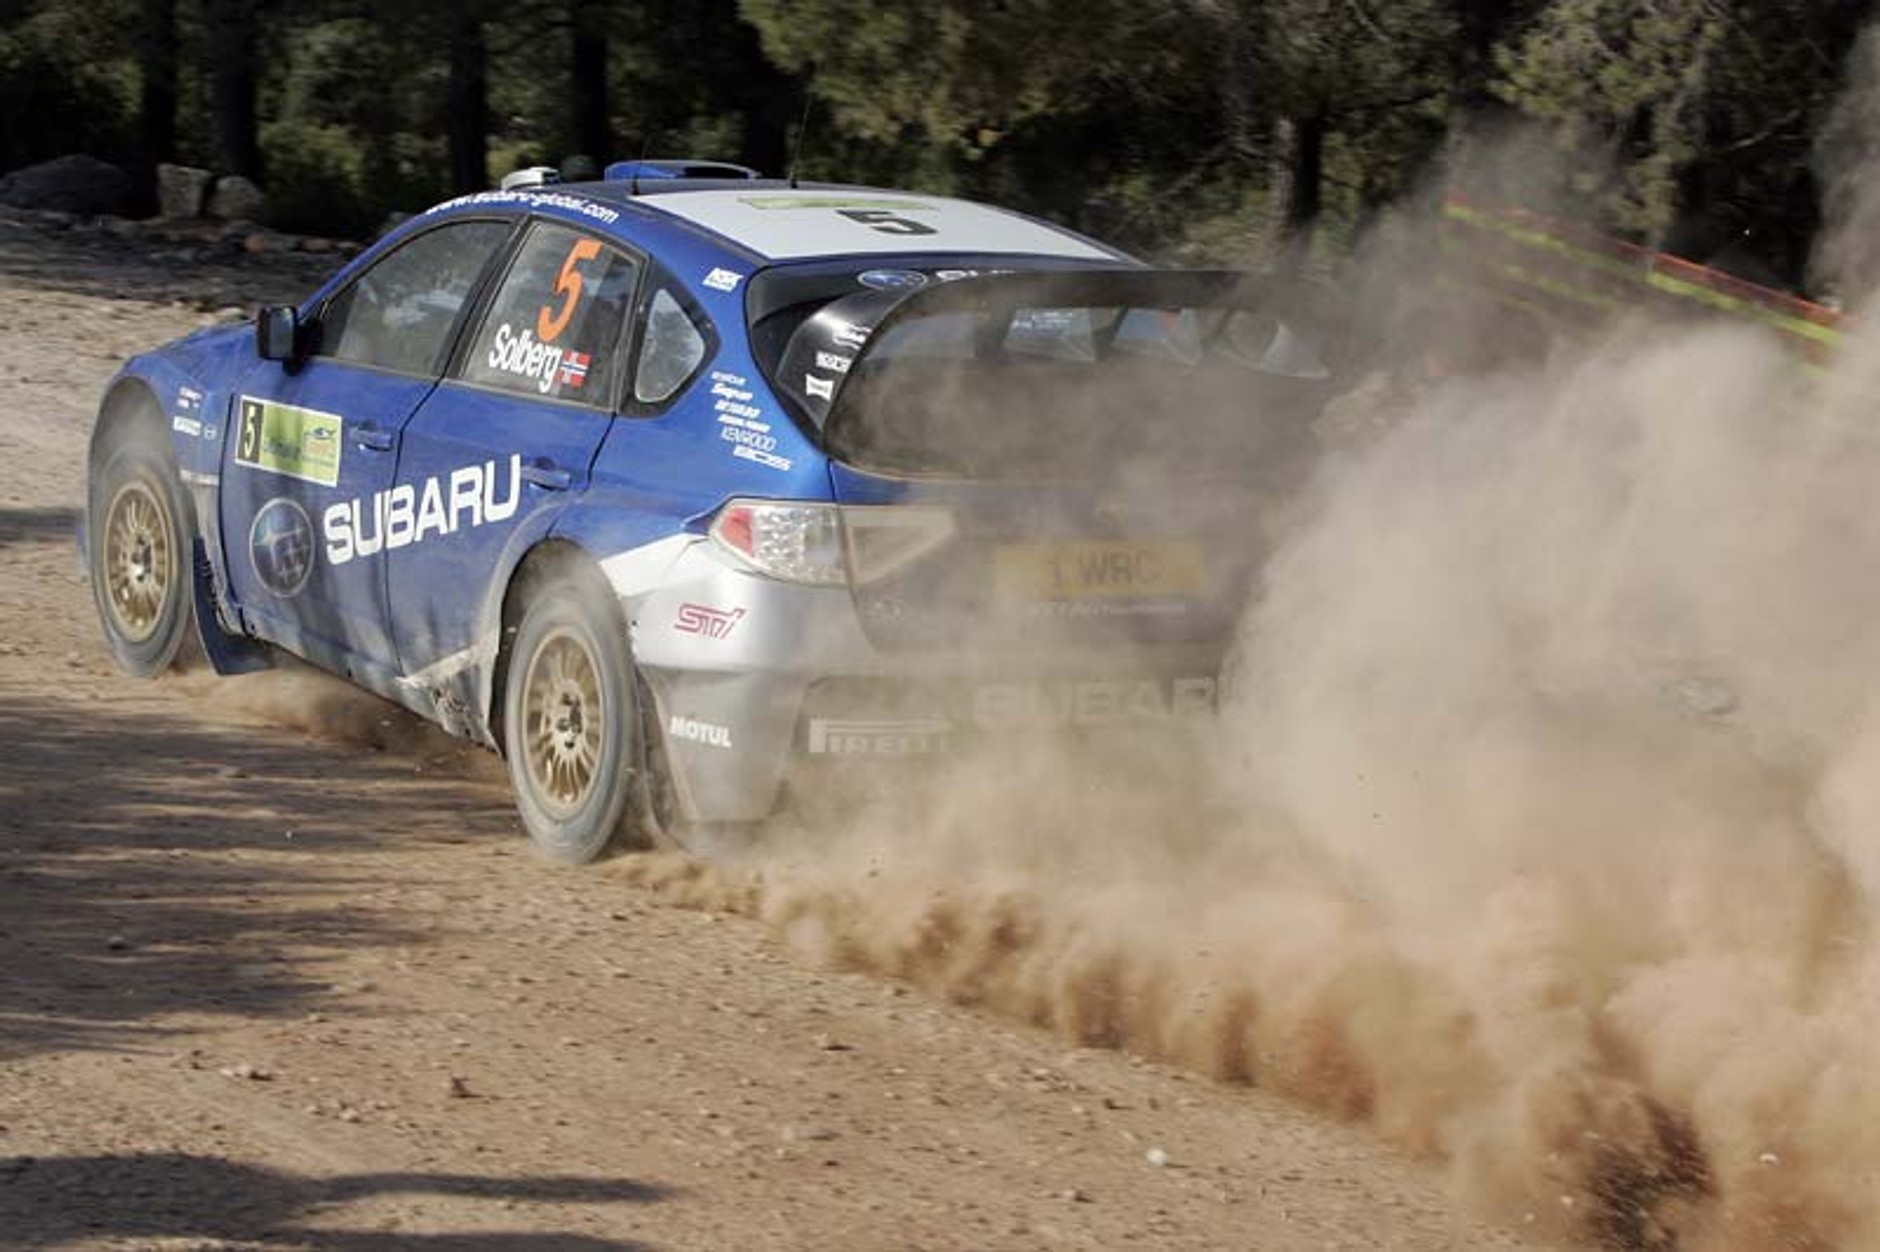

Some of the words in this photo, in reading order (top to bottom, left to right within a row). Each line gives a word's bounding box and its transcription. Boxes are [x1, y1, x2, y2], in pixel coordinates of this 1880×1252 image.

[836, 208, 939, 236] 5
[537, 237, 604, 342] 5
[488, 323, 564, 394] Solberg
[243, 404, 256, 459] 5
[323, 453, 521, 566] SUBARU
[669, 715, 733, 748] MOTUL
